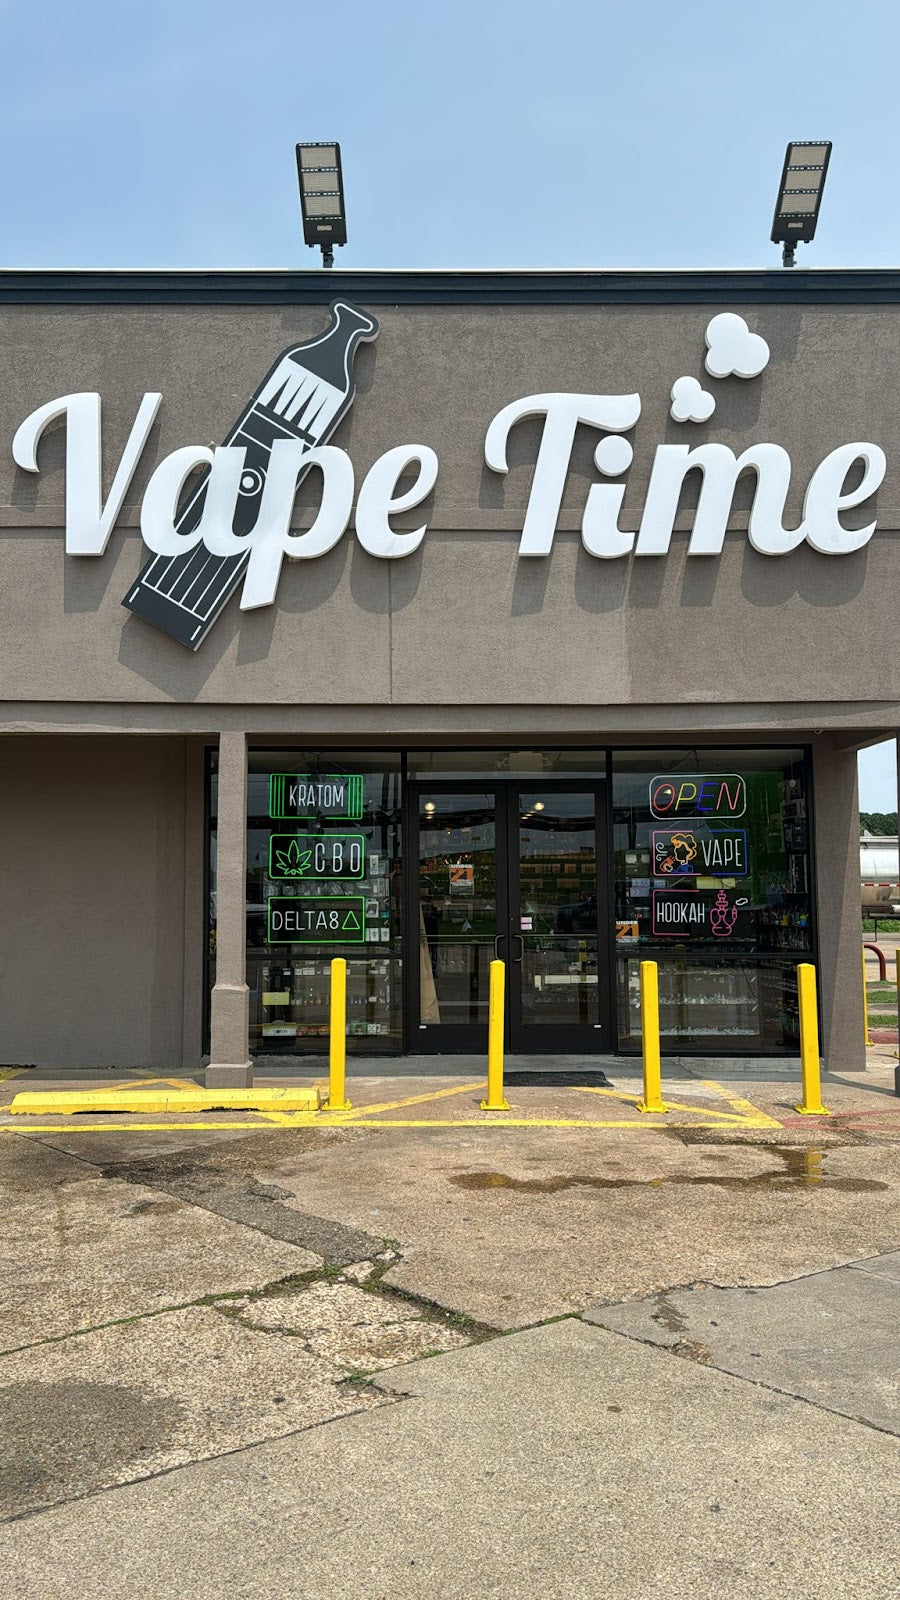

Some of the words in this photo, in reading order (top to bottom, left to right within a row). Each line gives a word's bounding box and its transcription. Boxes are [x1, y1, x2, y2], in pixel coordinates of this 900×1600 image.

[12, 392, 439, 611] Vape
[484, 392, 887, 559] Time
[289, 784, 344, 807] KRATOM
[653, 782, 742, 811] OPEN
[701, 838, 743, 867] VAPE
[450, 868, 473, 881] 21
[656, 902, 705, 924] HOOKAH
[615, 924, 639, 938] 21
